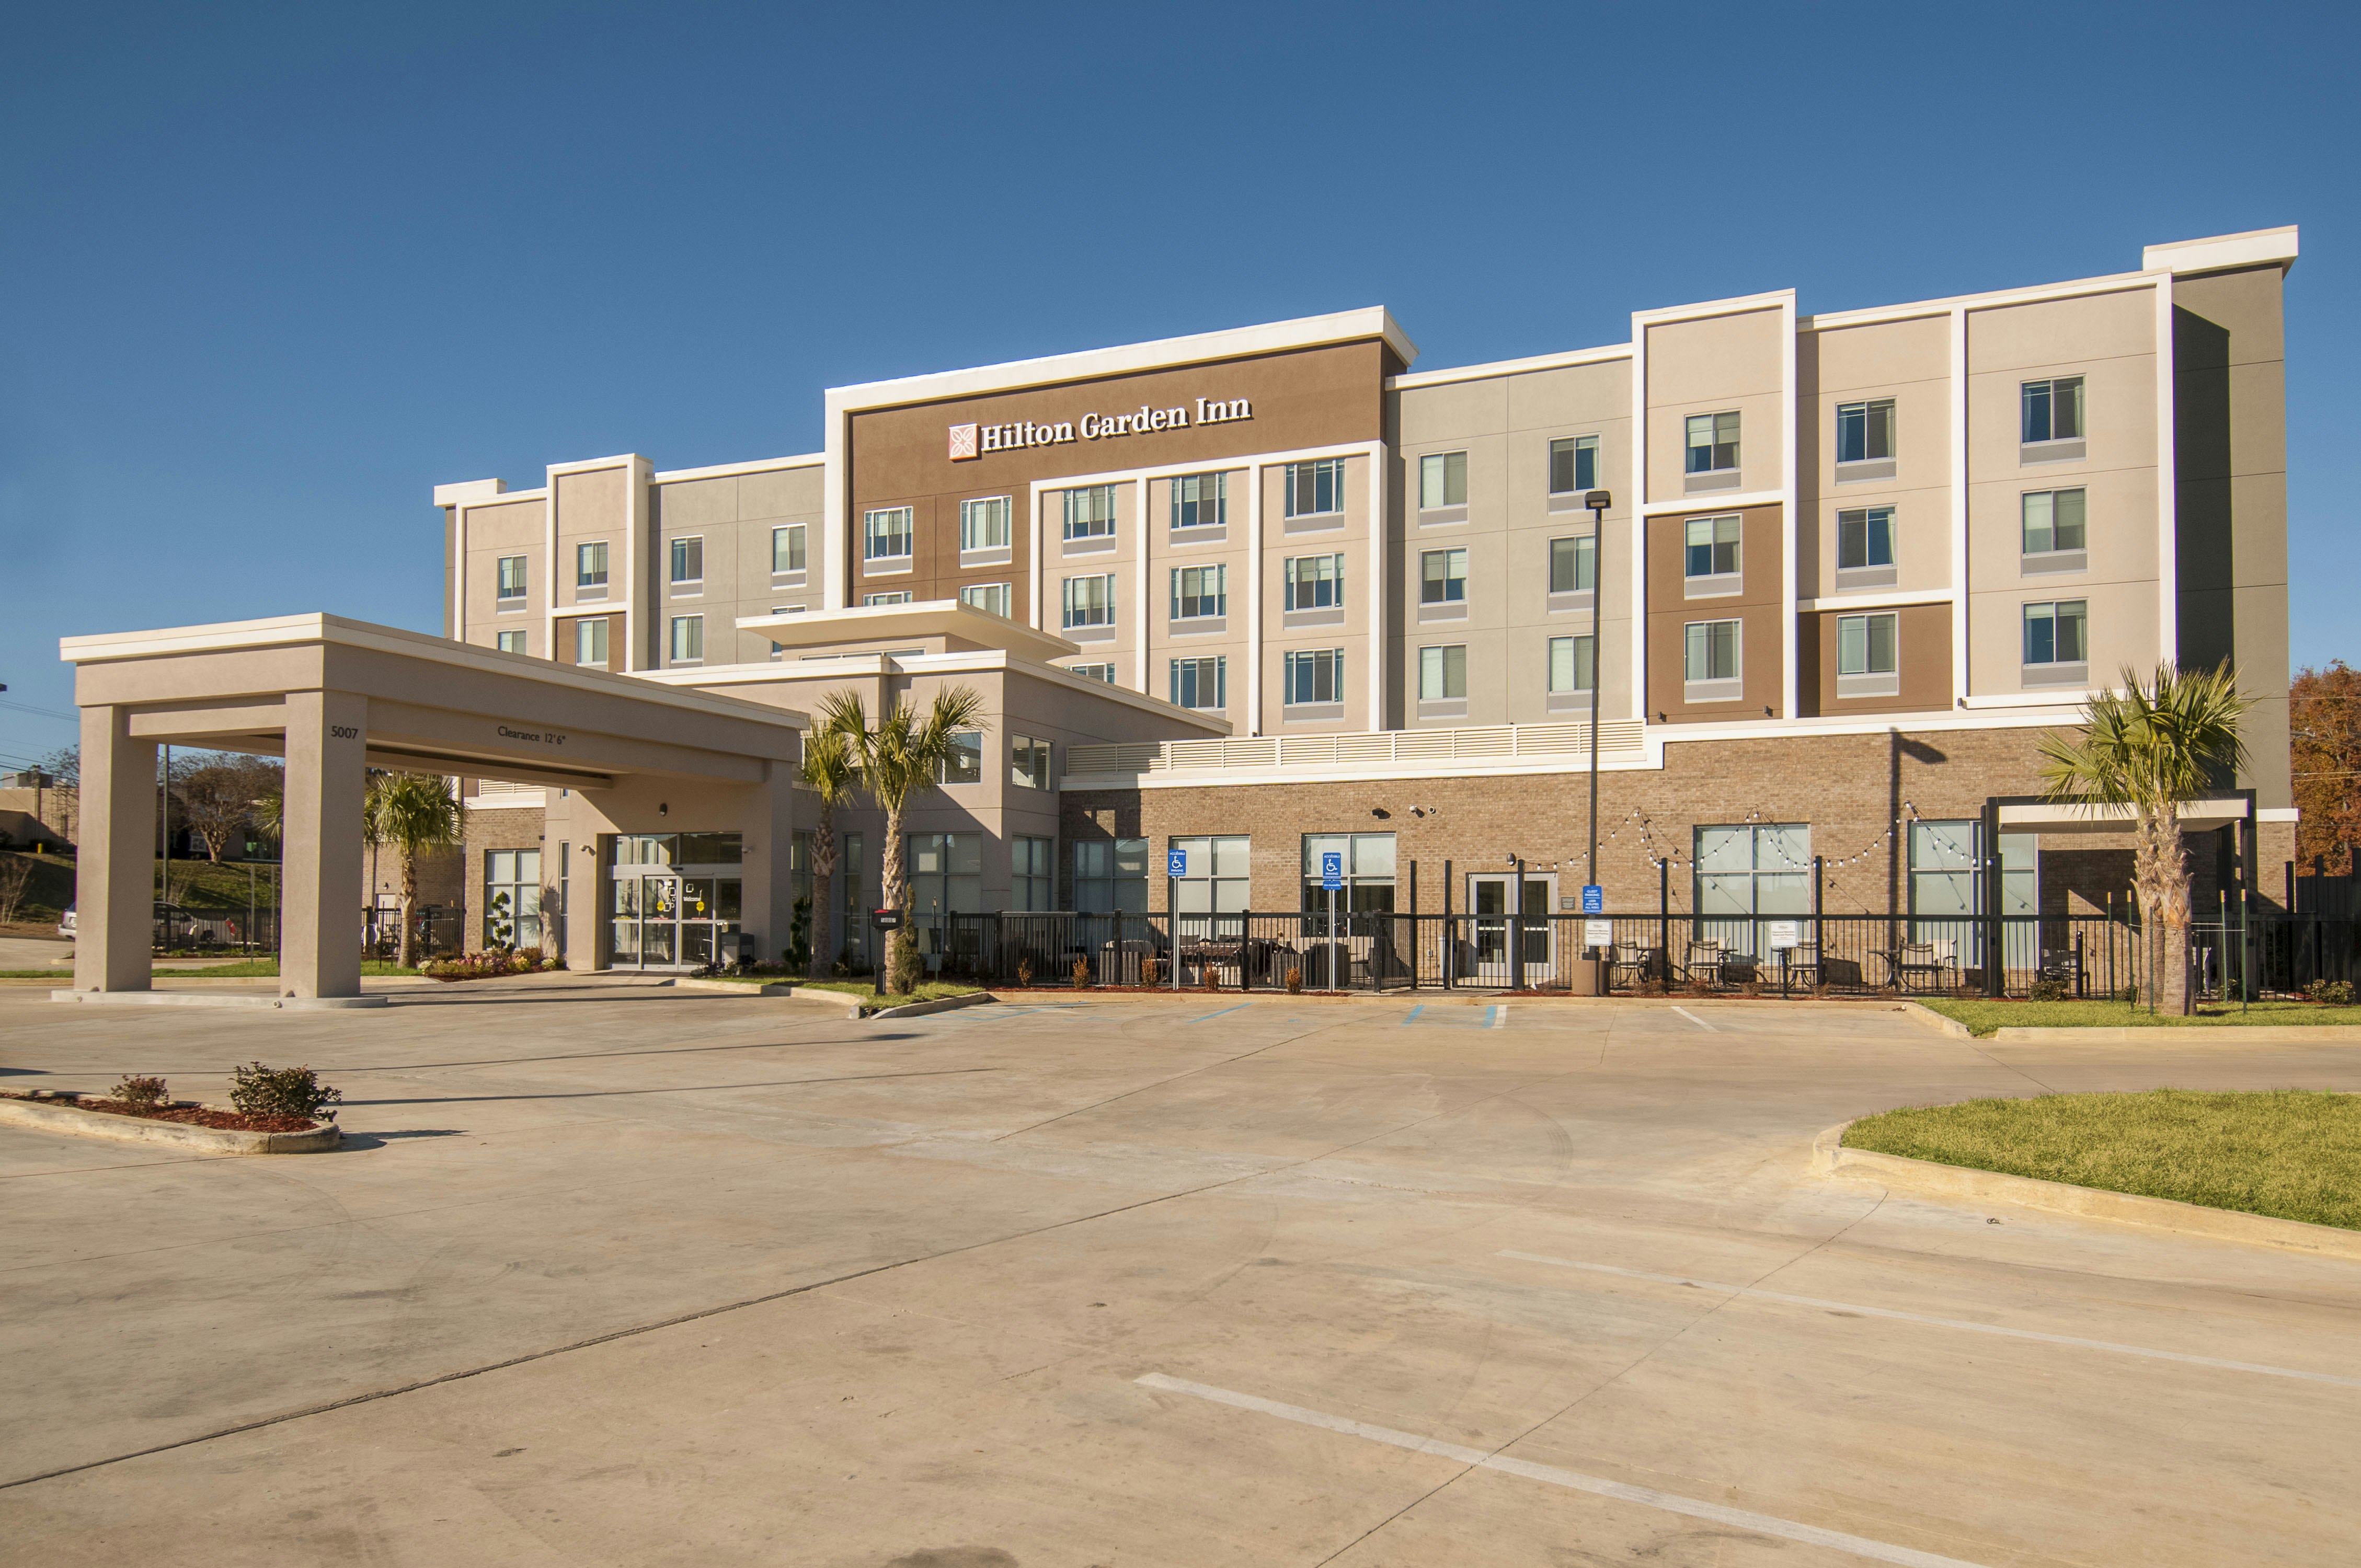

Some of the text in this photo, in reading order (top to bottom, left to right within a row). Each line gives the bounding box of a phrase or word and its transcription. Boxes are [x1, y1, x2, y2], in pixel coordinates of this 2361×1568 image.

[981, 397, 1251, 451] Hilton Garden Inn
[330, 725, 359, 740] 5007
[498, 726, 540, 741] Clearance
